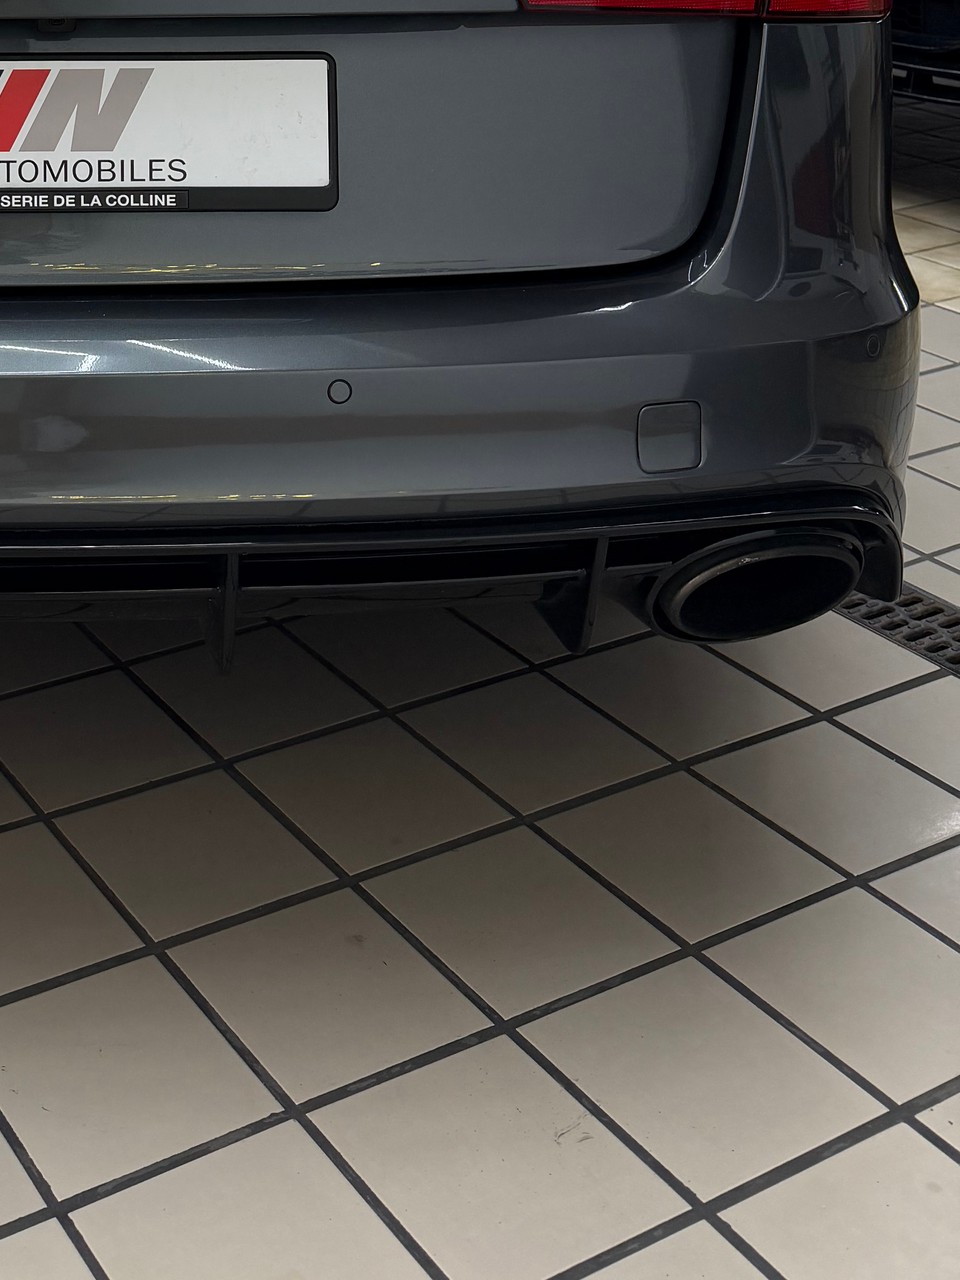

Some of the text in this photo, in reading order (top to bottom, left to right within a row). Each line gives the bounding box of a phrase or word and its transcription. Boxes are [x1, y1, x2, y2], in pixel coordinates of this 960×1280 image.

[53, 195, 76, 207] DE
[80, 194, 102, 207] LA
[105, 194, 177, 207] COLLINE
